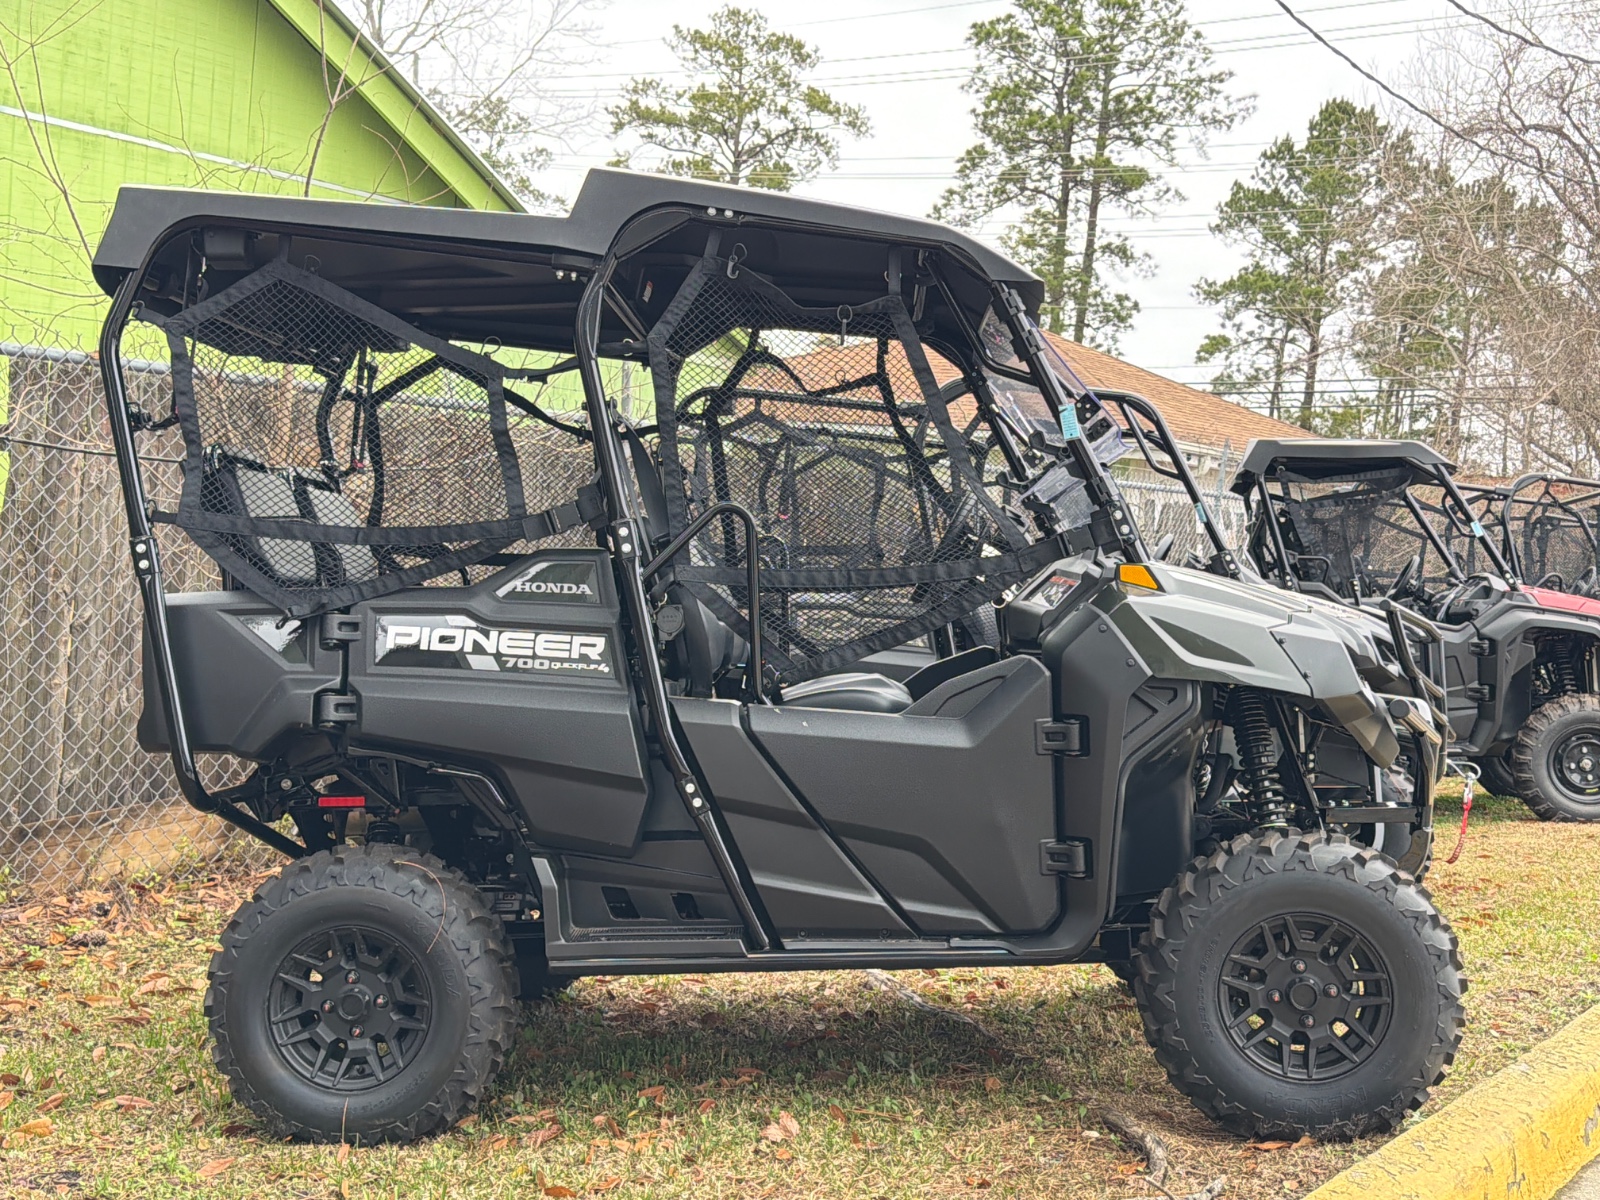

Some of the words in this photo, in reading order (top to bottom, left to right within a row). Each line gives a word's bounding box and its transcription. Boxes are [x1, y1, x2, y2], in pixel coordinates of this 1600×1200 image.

[514, 581, 593, 595] HONDA
[385, 625, 606, 661] PIONEER
[501, 657, 550, 670] 700
